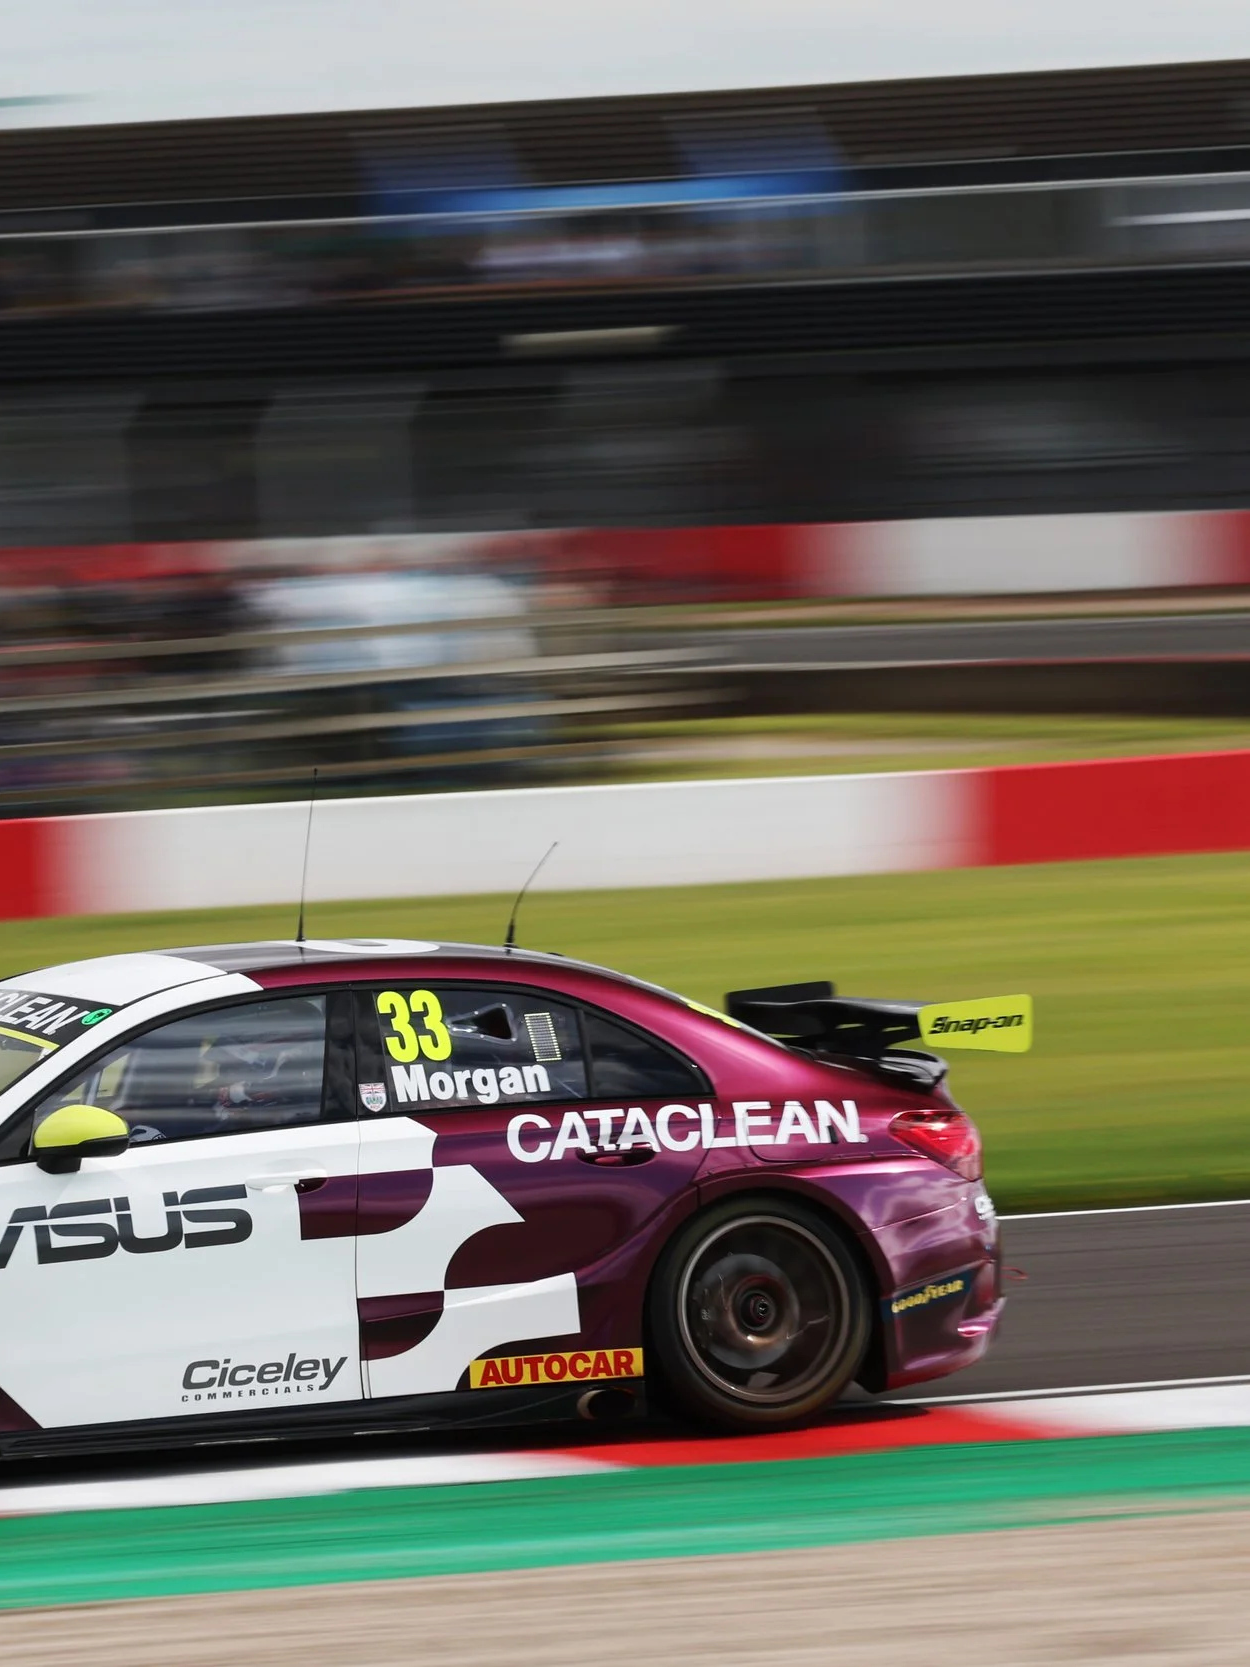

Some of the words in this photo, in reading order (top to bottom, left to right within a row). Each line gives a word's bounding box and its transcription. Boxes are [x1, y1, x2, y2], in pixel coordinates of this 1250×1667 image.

[377, 989, 452, 1063] 33
[927, 1014, 1025, 1035] Snap-on
[390, 1063, 551, 1104] Morgan
[506, 1100, 864, 1163] CATACLEAN
[182, 1353, 348, 1391] Ciceley
[479, 1350, 635, 1386] AUTOCAR
[181, 1384, 314, 1402] COMMERCIALS
